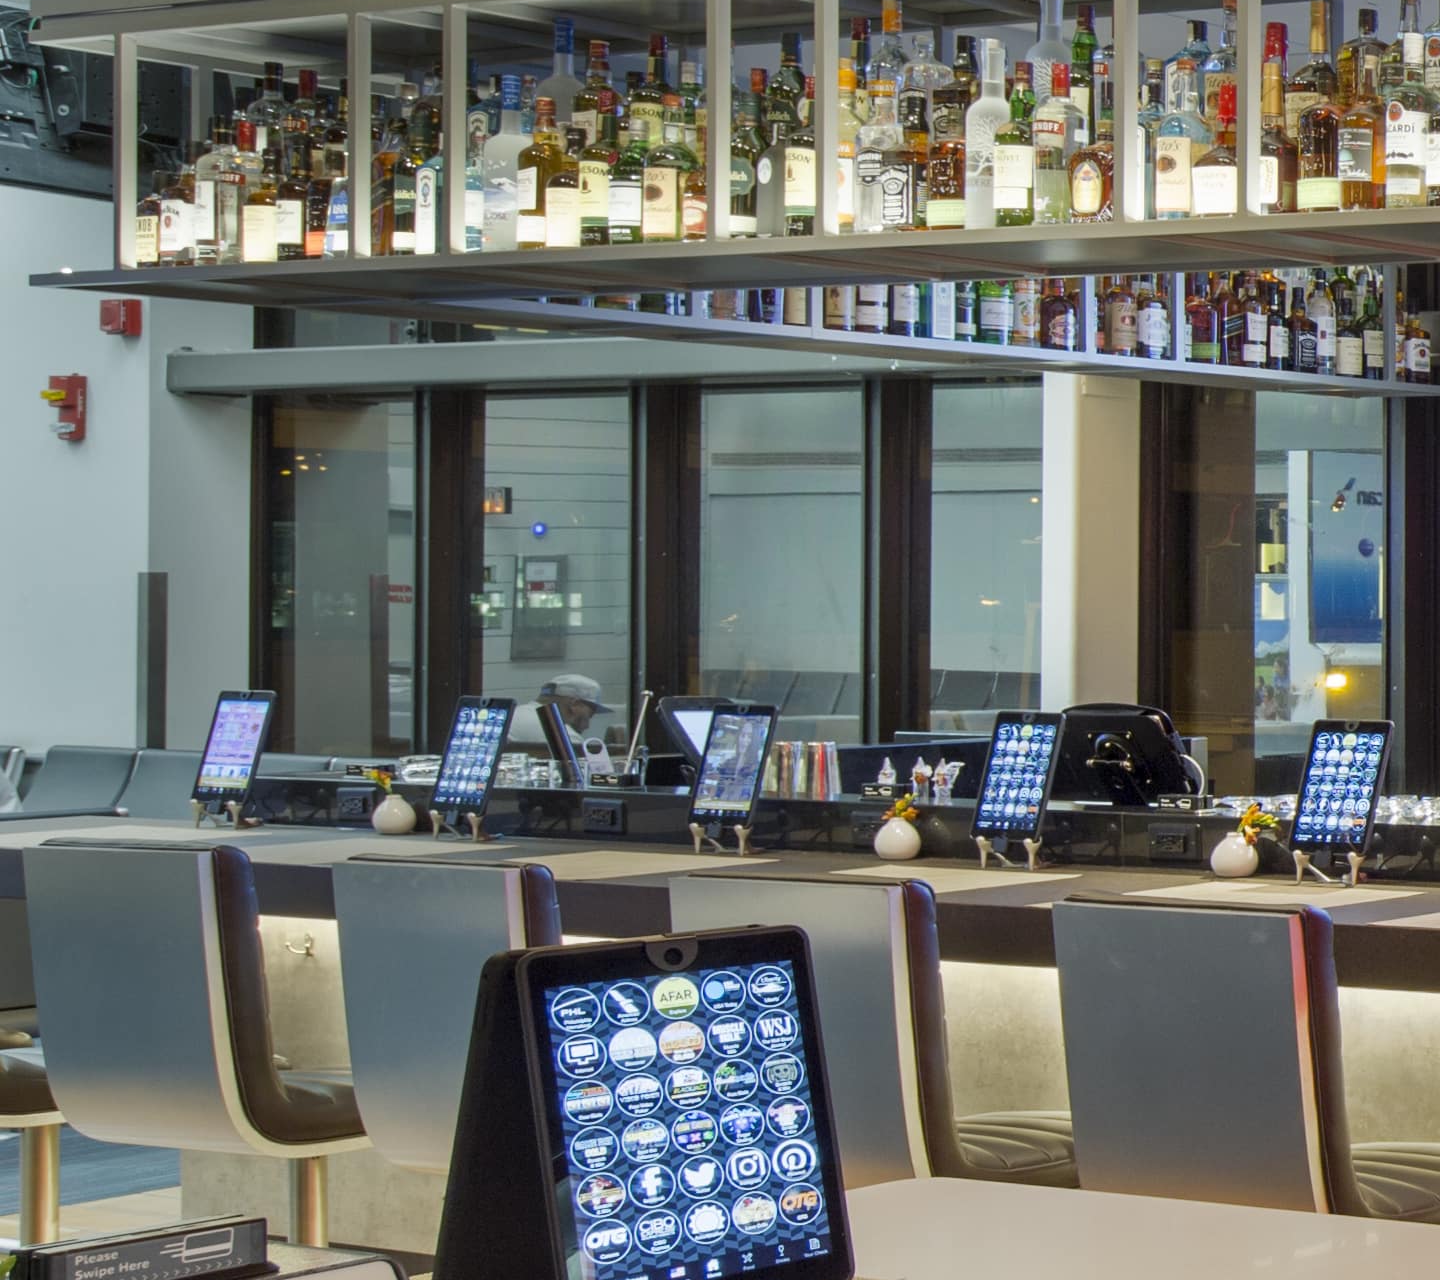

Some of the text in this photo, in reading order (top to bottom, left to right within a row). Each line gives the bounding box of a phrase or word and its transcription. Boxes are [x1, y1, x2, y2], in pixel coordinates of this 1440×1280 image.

[660, 988, 692, 1003] AFAR
[561, 1007, 585, 1017] PHL
[761, 1017, 791, 1038] WSJ
[586, 1228, 627, 1249] OTG
[75, 1251, 118, 1266] Please
[75, 1260, 149, 1280] Swipe Here
